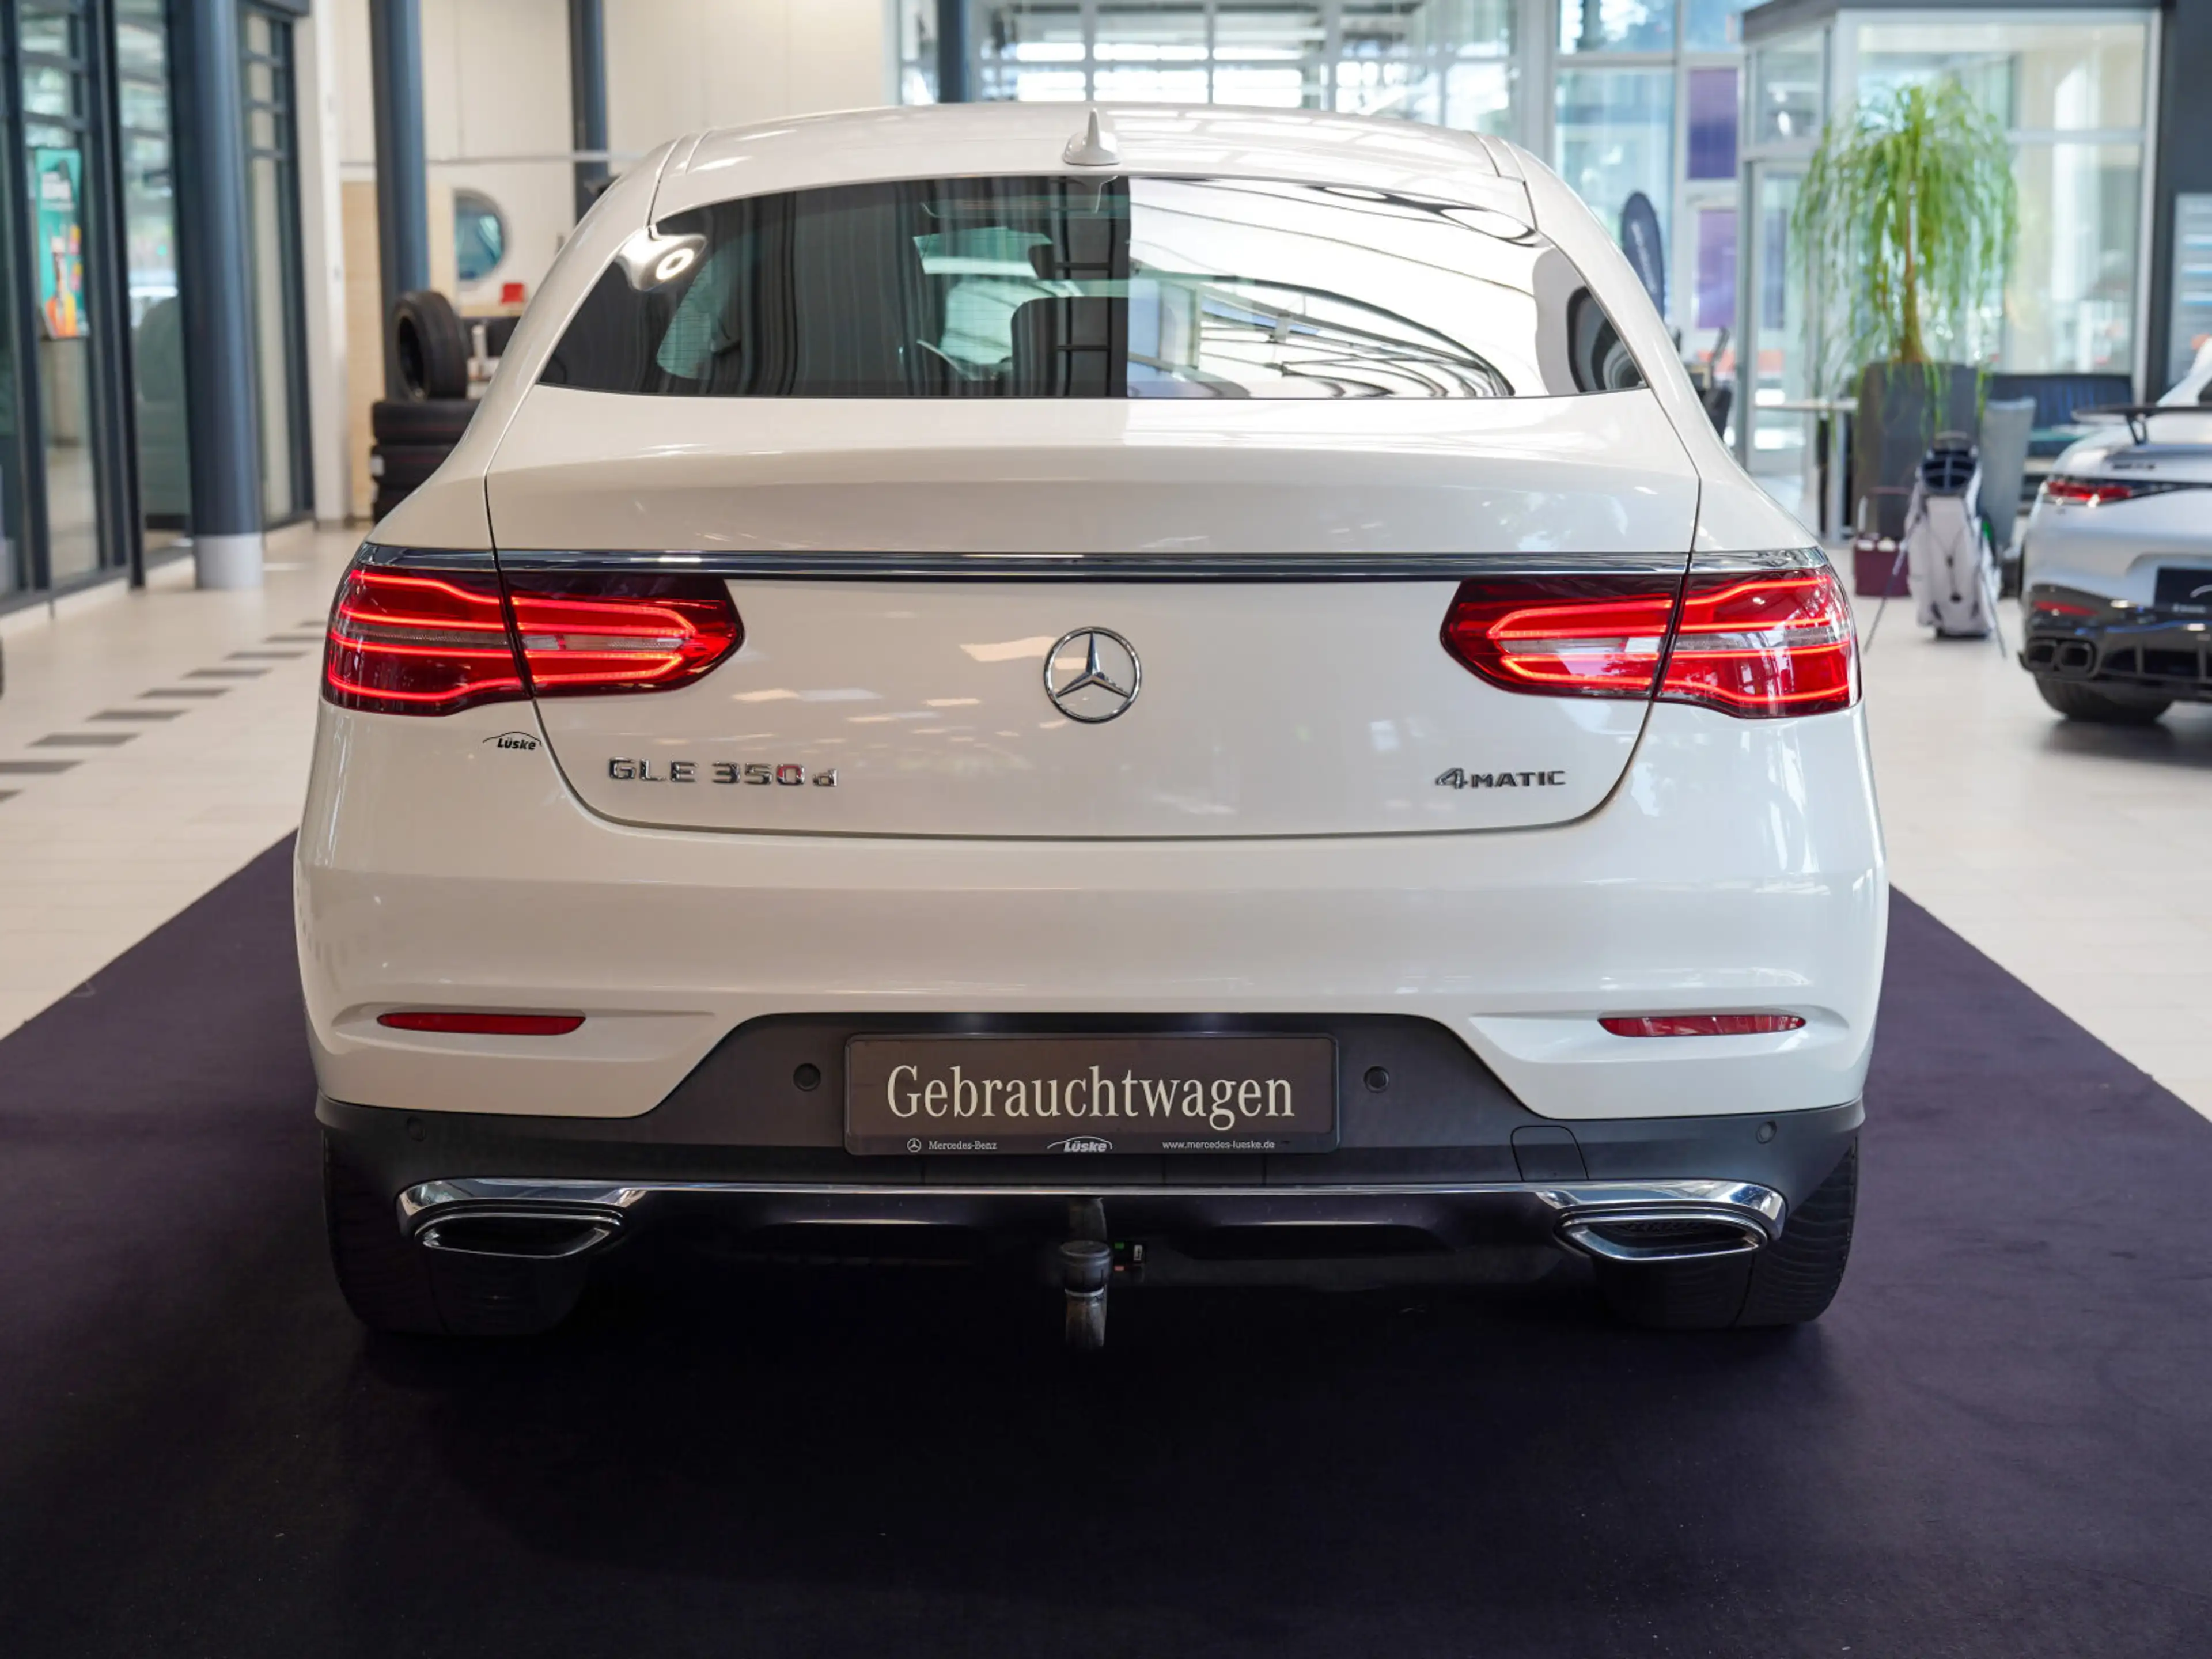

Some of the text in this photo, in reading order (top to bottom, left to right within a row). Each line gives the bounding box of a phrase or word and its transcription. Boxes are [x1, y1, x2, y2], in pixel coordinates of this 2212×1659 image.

[497, 737, 536, 750] Lüske
[608, 757, 698, 783] GLE
[1434, 767, 1566, 789] 4MATIC
[887, 1064, 1296, 1131] Gebrauchtwagen
[928, 1140, 998, 1150] Mercedes-Benz
[1063, 1139, 1108, 1152] Lüske
[1162, 1139, 1275, 1150] www.mercedes-lueske.de
